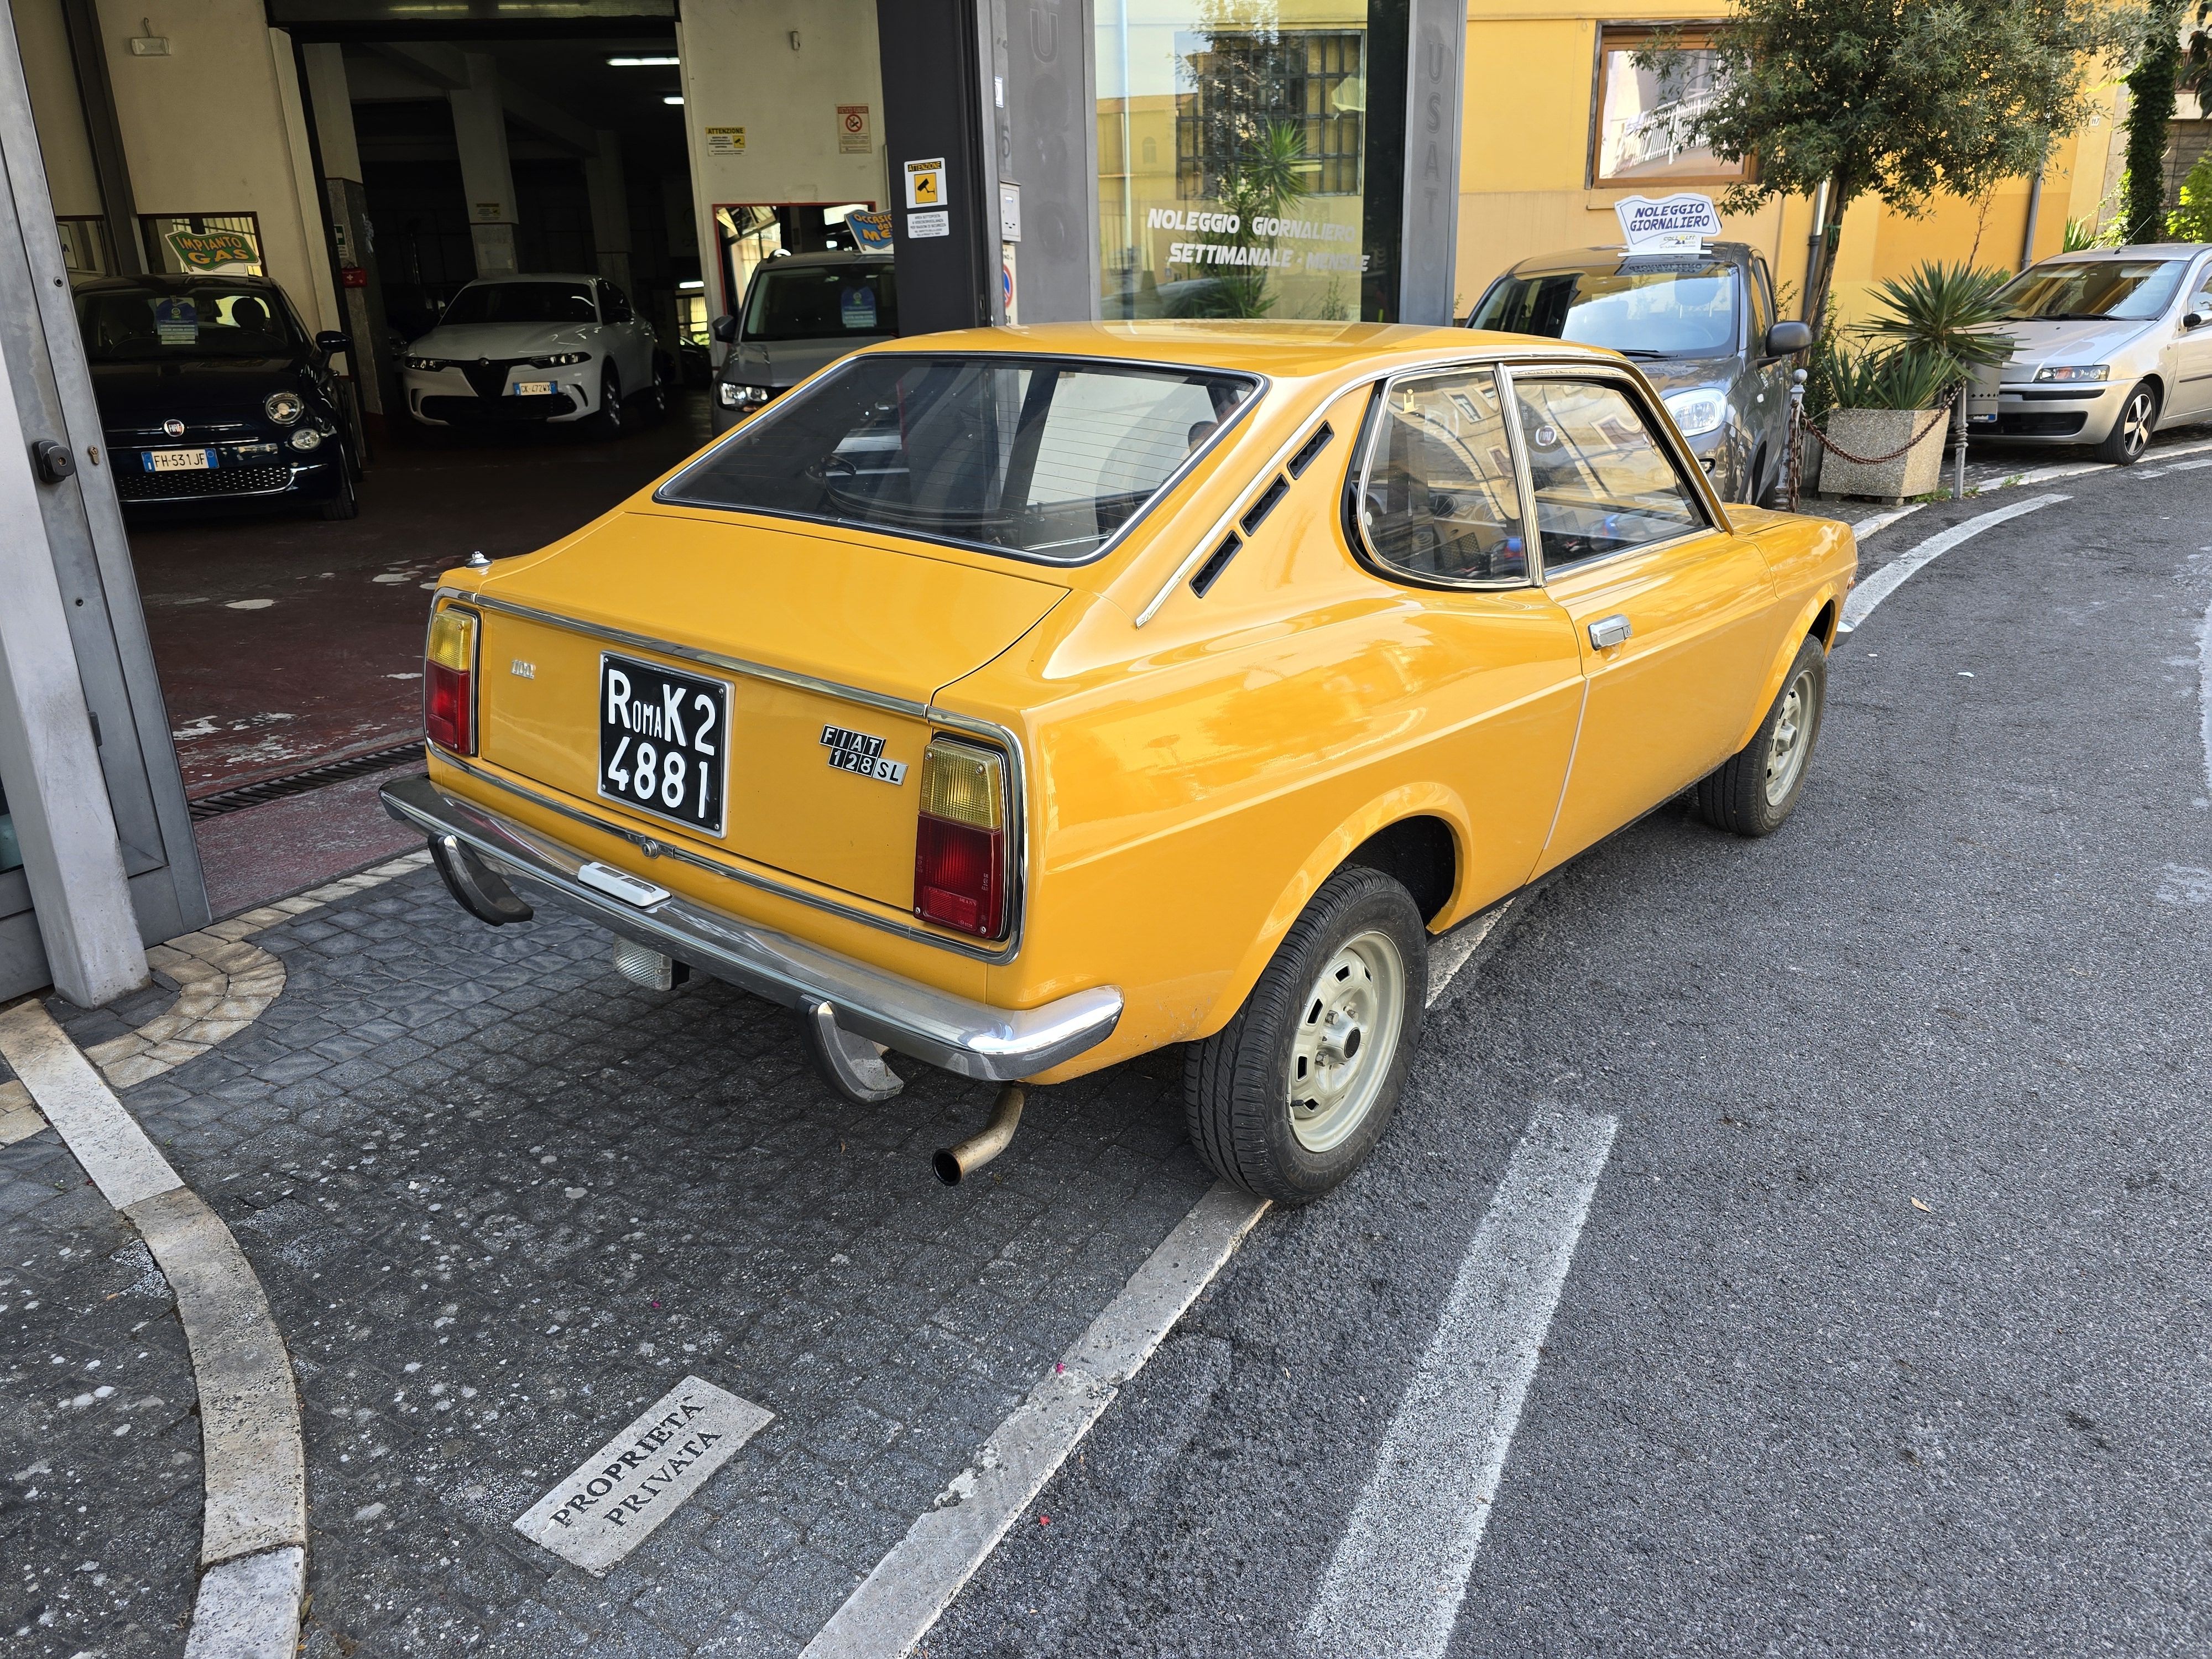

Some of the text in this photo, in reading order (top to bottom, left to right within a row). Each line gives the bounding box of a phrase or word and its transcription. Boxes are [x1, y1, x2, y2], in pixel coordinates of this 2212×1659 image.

[909, 161, 941, 171] ATTENZIONE
[1635, 203, 1705, 218] NOLEGGIO
[1147, 208, 1355, 242] NOLEGGIO GIORNALIERO
[1630, 215, 1710, 232] GIORNALIERO
[175, 236, 242, 251] IMPIANTO
[188, 249, 249, 264] GAS
[1168, 242, 1294, 268] SETTIMANALE
[1305, 252, 1371, 272] MENSILE
[169, 424, 181, 432] FIAT
[1540, 431, 1552, 441] FIAT
[823, 728, 879, 755] FIAT
[834, 750, 899, 782] 128 SL
[608, 736, 708, 818] 4881
[603, 1430, 722, 1527] PRIVATA
